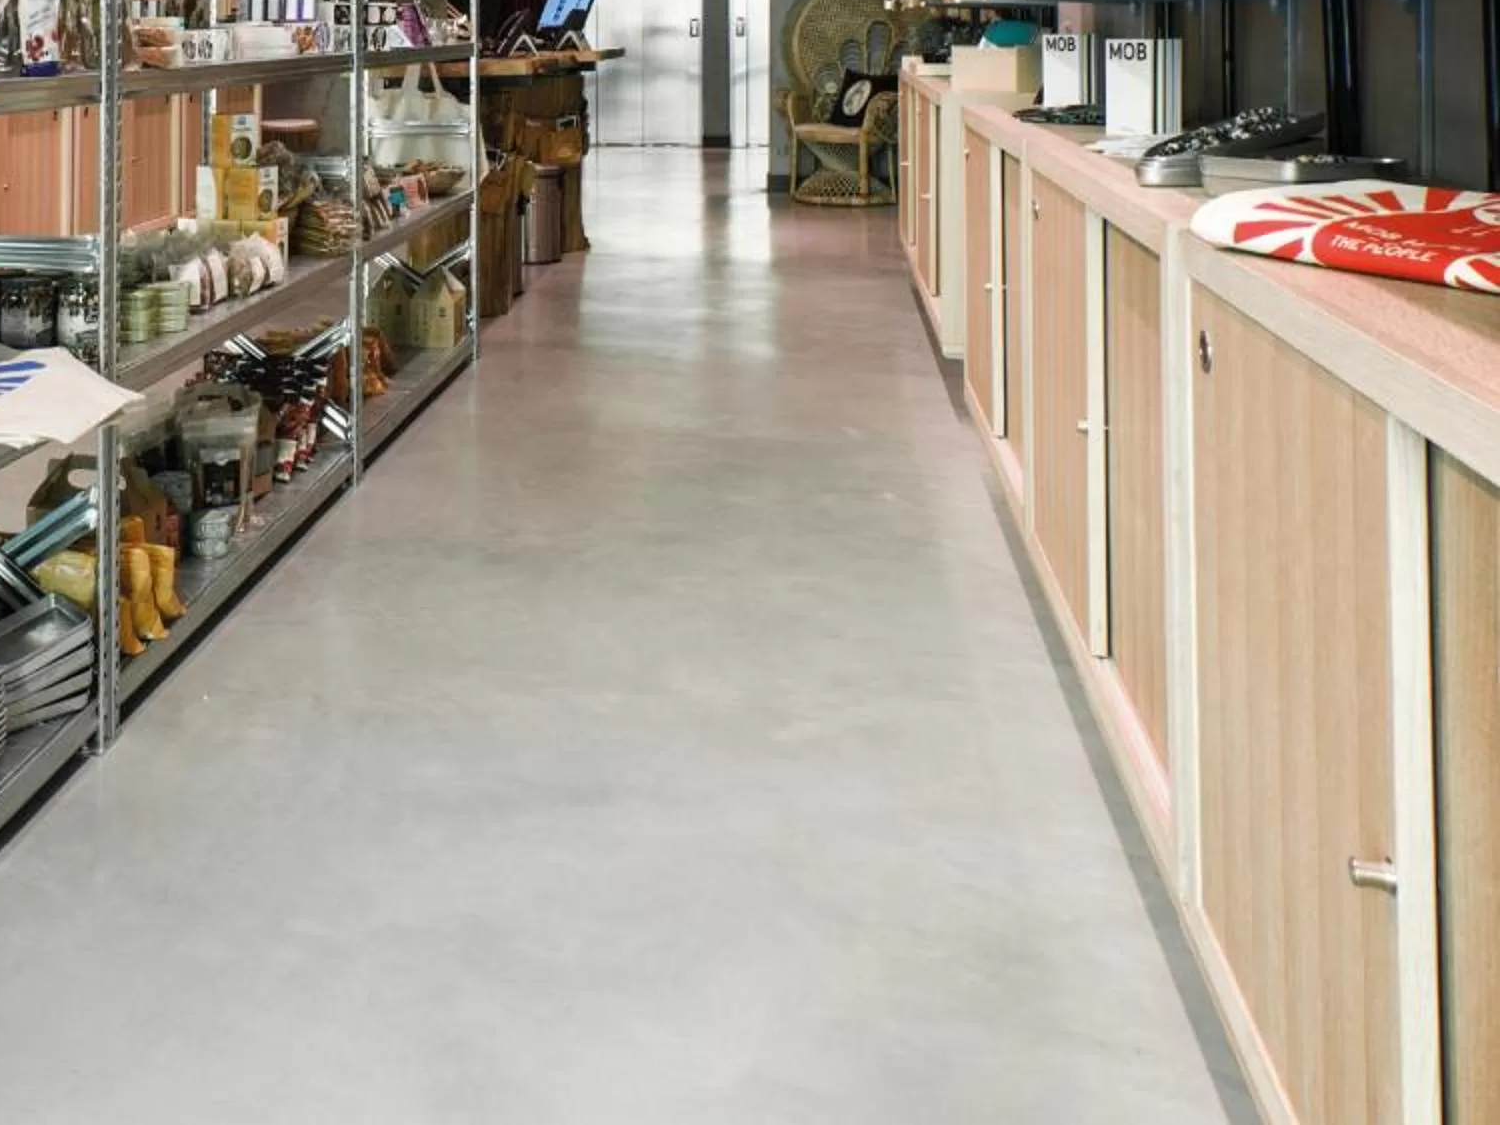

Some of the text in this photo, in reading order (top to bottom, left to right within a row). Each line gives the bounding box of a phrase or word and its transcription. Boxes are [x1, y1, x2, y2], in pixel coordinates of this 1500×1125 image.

[1045, 36, 1077, 52] MOB
[1109, 42, 1148, 61] MOB
[1331, 233, 1440, 263] THE PEOPLE
